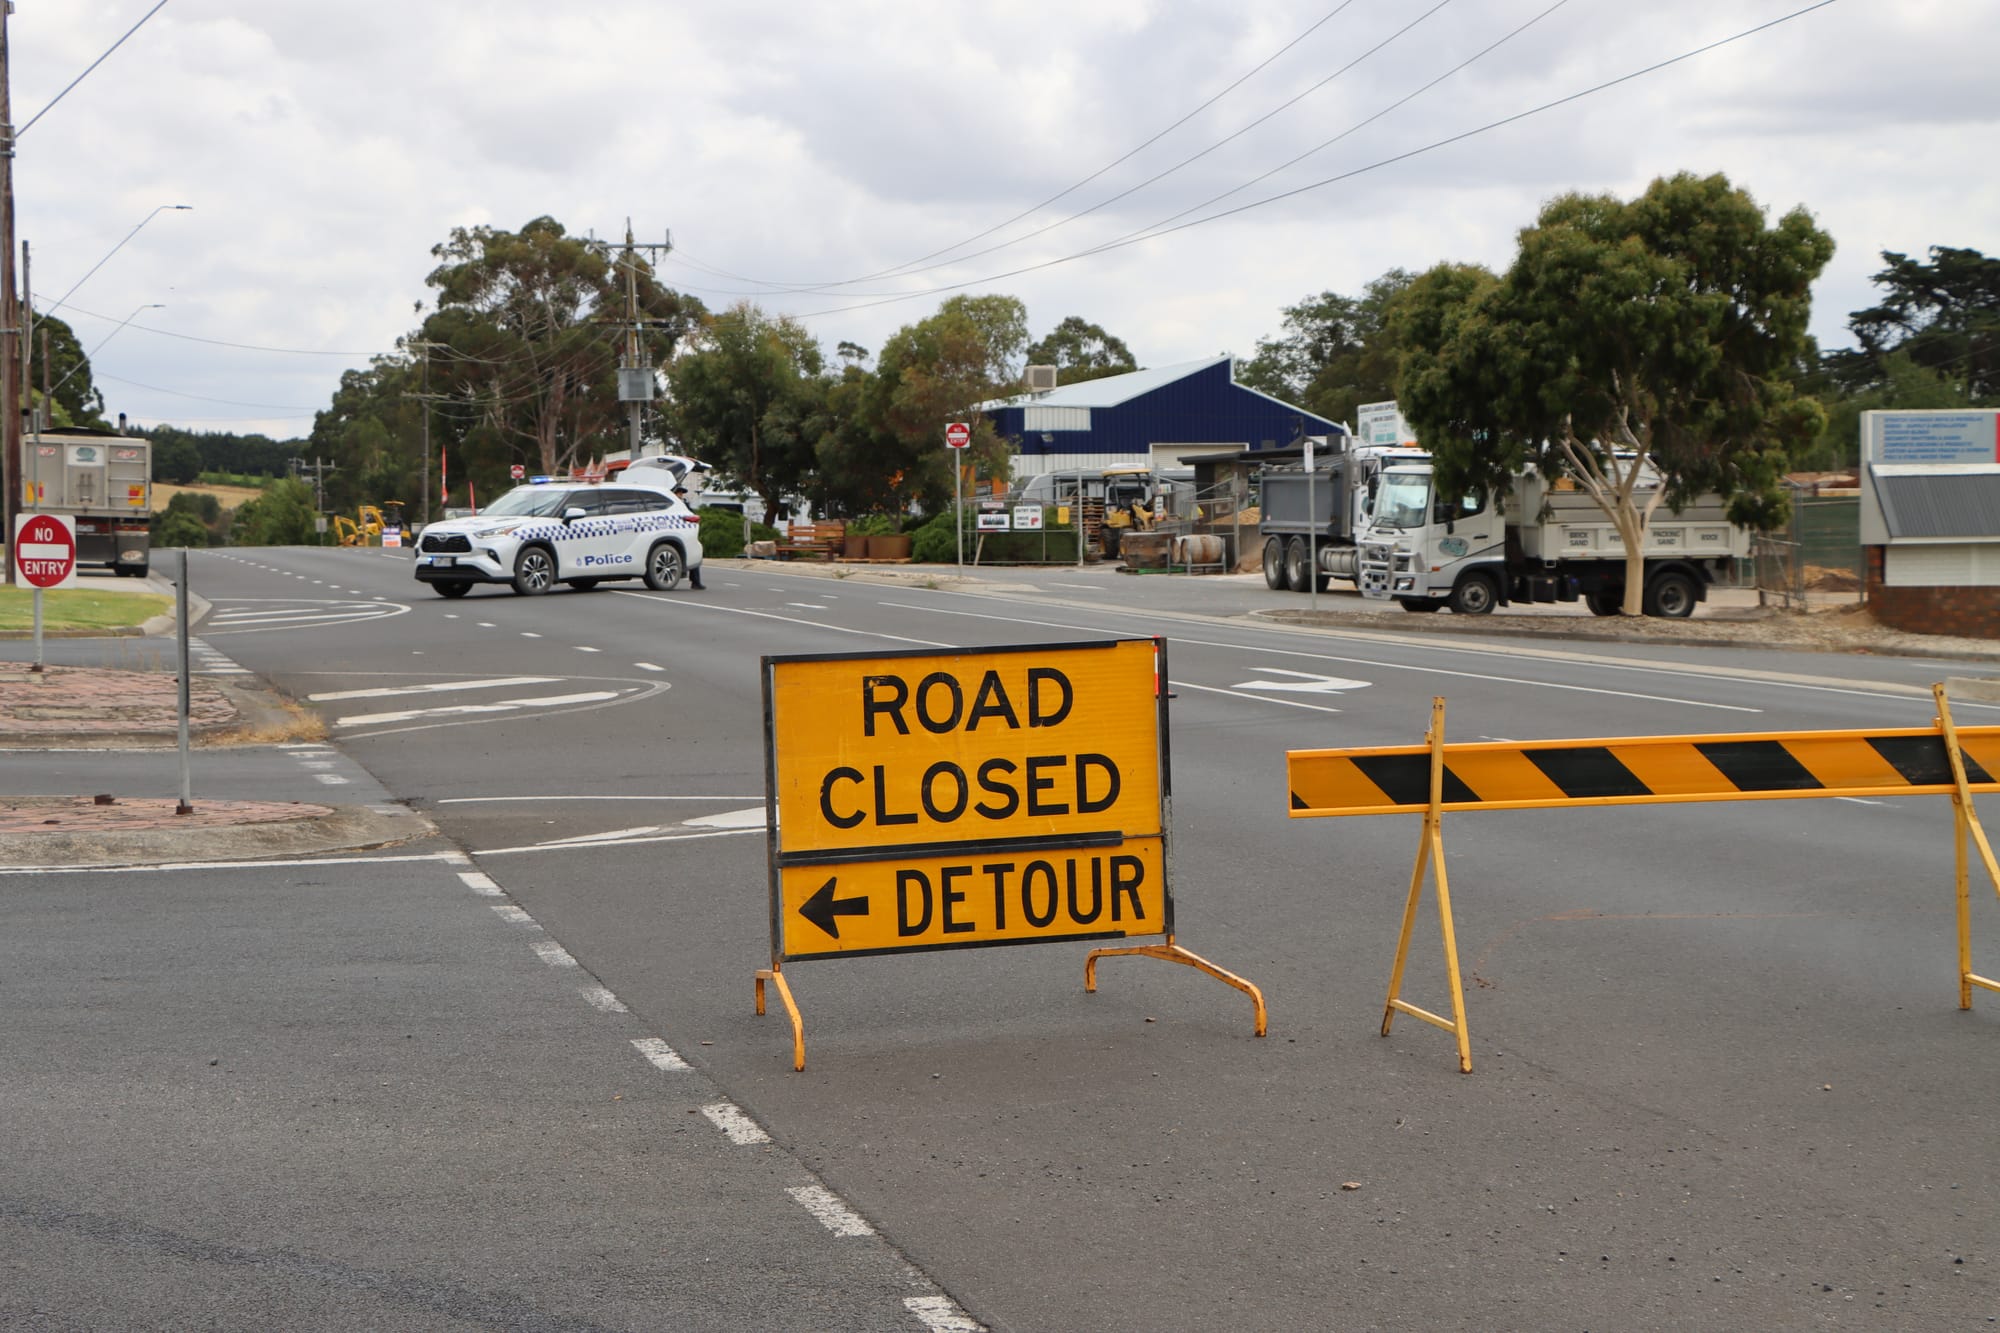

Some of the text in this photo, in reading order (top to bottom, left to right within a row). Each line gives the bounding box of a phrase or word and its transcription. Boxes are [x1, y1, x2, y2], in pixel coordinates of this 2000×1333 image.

[34, 527, 54, 542] NO
[24, 560, 67, 576] ENTRY
[584, 554, 632, 566] Police
[863, 667, 1073, 737] ROAD
[820, 753, 1121, 829] CLOSED
[896, 855, 1145, 937] DETOUR
